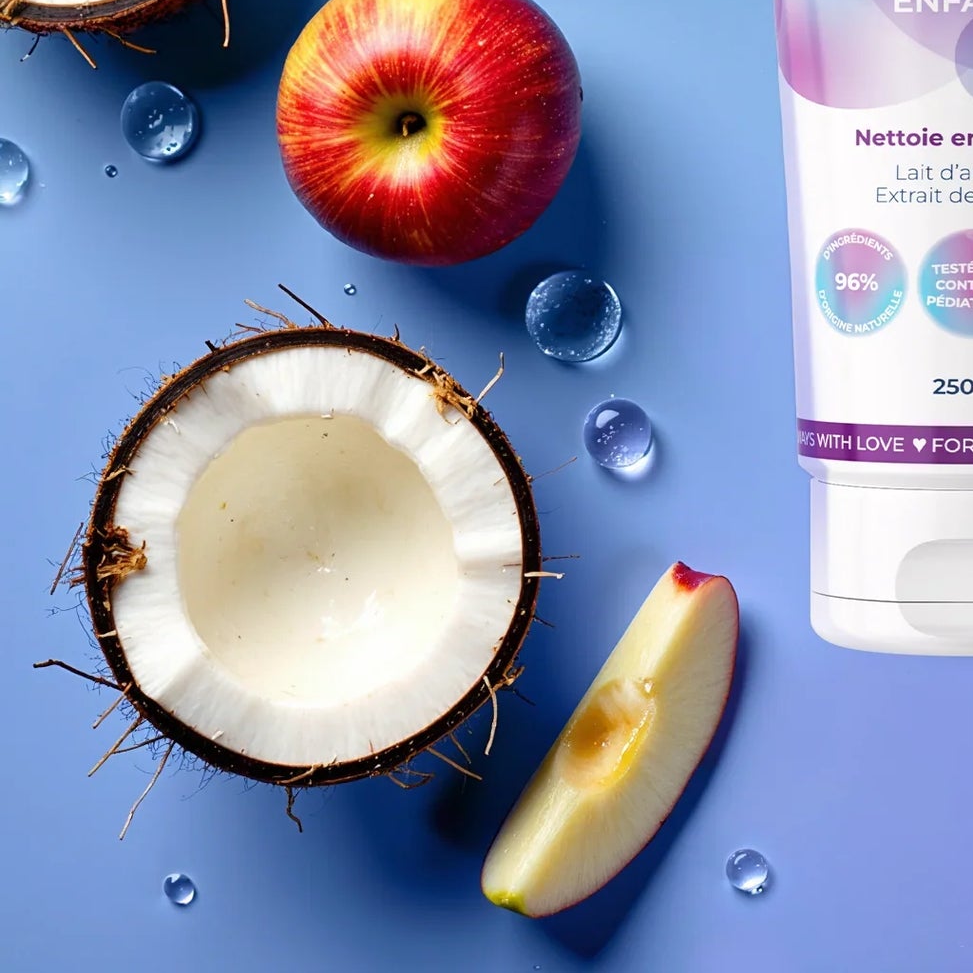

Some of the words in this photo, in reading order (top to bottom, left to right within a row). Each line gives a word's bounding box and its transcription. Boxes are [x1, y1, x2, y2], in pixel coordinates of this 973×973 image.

[855, 128, 943, 147] Nettoie
[895, 164, 933, 181] Lait
[876, 187, 943, 203] Extrait
[823, 232, 893, 261] D'INGRÉDIENTS
[834, 272, 879, 291] 96%
[854, 289, 903, 333] NATURELLE
[816, 433, 852, 450] WITH
[856, 435, 905, 452] LOVE
